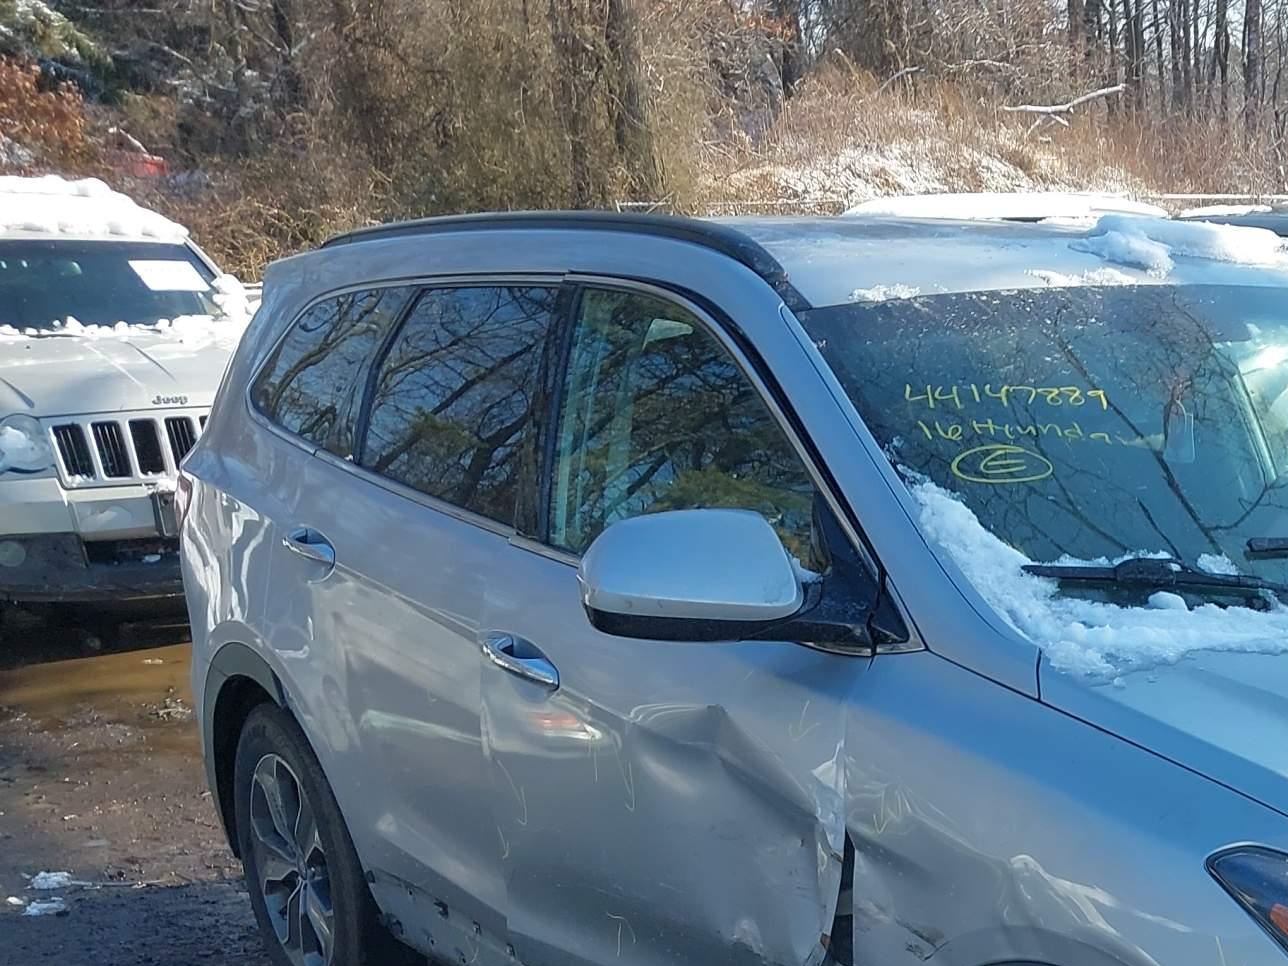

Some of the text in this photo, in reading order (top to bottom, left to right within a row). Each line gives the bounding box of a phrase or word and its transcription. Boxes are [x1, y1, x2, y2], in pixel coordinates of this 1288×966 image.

[152, 395, 188, 406] Jeep
[904, 383, 1109, 411] 44147889
[916, 419, 963, 441] 16
